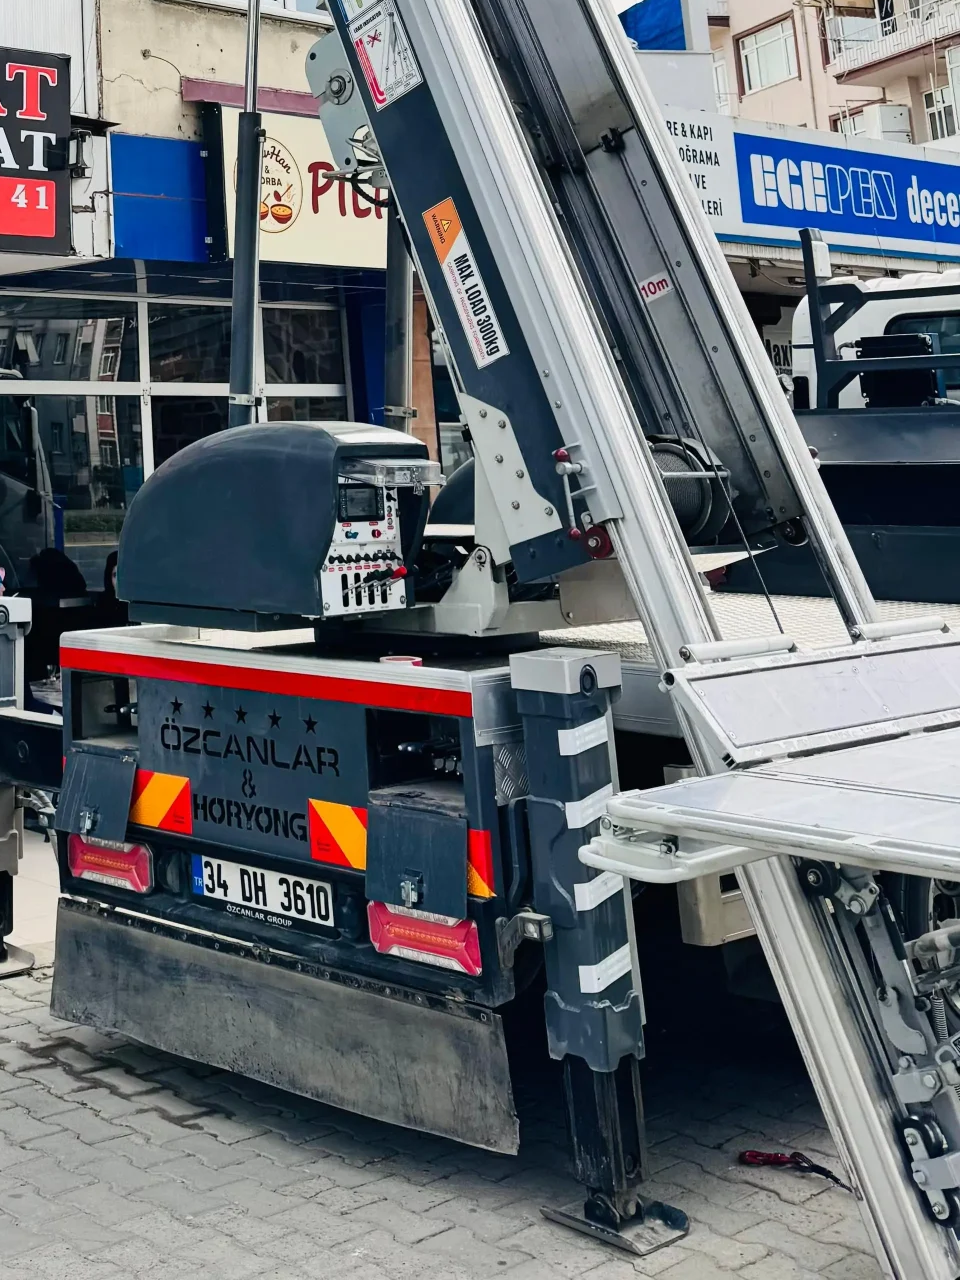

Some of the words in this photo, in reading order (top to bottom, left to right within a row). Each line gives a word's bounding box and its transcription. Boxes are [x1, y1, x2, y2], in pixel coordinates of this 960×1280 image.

[681, 123, 687, 138] &
[689, 123, 713, 141] KAPI
[678, 145, 720, 167] OĞRAMA
[261, 177, 282, 187] ORBA
[694, 174, 706, 190] VE
[750, 154, 897, 220] EGEPEN
[10, 184, 49, 210] 41
[907, 175, 960, 228] dece
[432, 213, 446, 244] WARNING
[640, 276, 669, 299] 10m
[454, 253, 474, 286] MAX.
[465, 283, 487, 317] LOAD
[477, 314, 500, 357] 300kg
[160, 716, 340, 777] ÖZCANLAR
[241, 769, 257, 798] &
[193, 793, 308, 842] HORYONG
[194, 876, 203, 887] TR
[204, 860, 229, 897] 34
[240, 868, 267, 906] DH
[278, 877, 330, 922] 3610
[226, 903, 265, 921] ÖZCANLAR
[267, 914, 292, 927] GROUP
